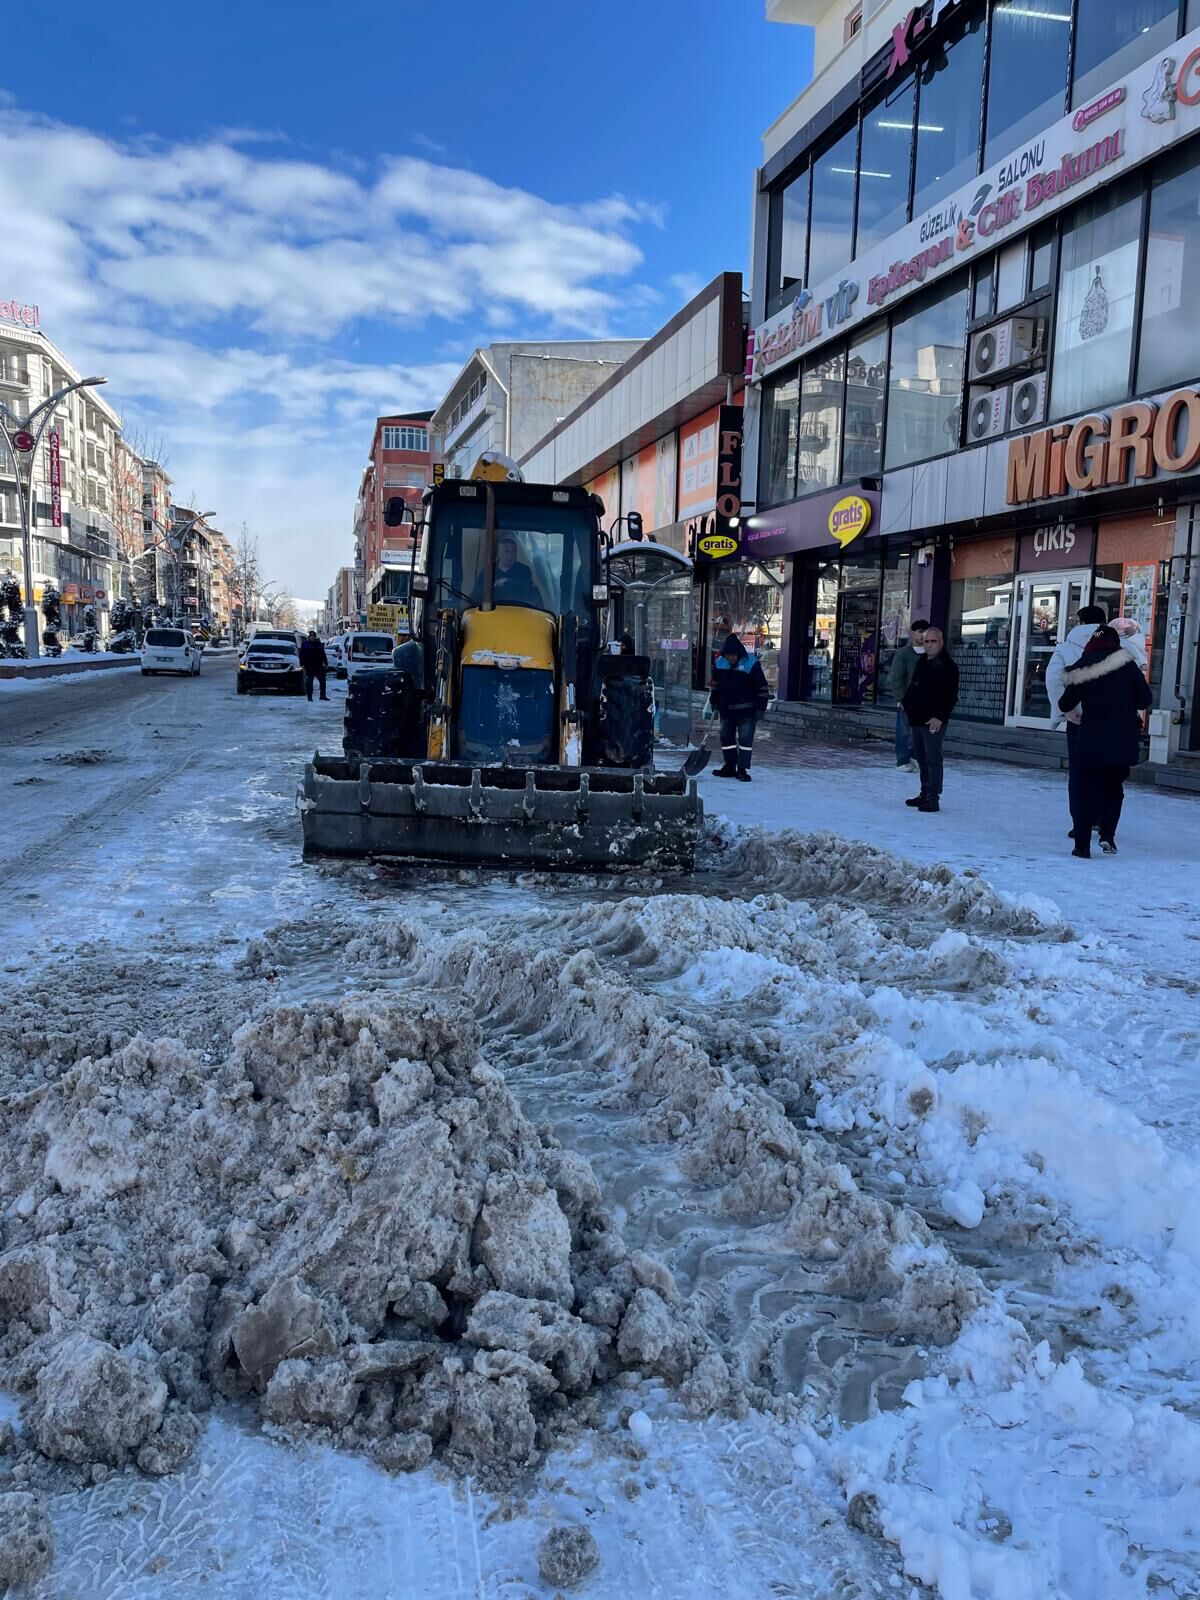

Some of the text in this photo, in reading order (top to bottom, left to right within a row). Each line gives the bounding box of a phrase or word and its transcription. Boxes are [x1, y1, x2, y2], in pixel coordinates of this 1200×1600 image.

[867, 129, 1124, 305] Epilasyon & Cilt Bakımı
[920, 140, 1045, 243] GÜZELLİK SALONU
[717, 431, 742, 517] FLO
[703, 539, 734, 551] gratis
[832, 500, 863, 533] gratis
[1033, 523, 1076, 558] ÇIKIŞ
